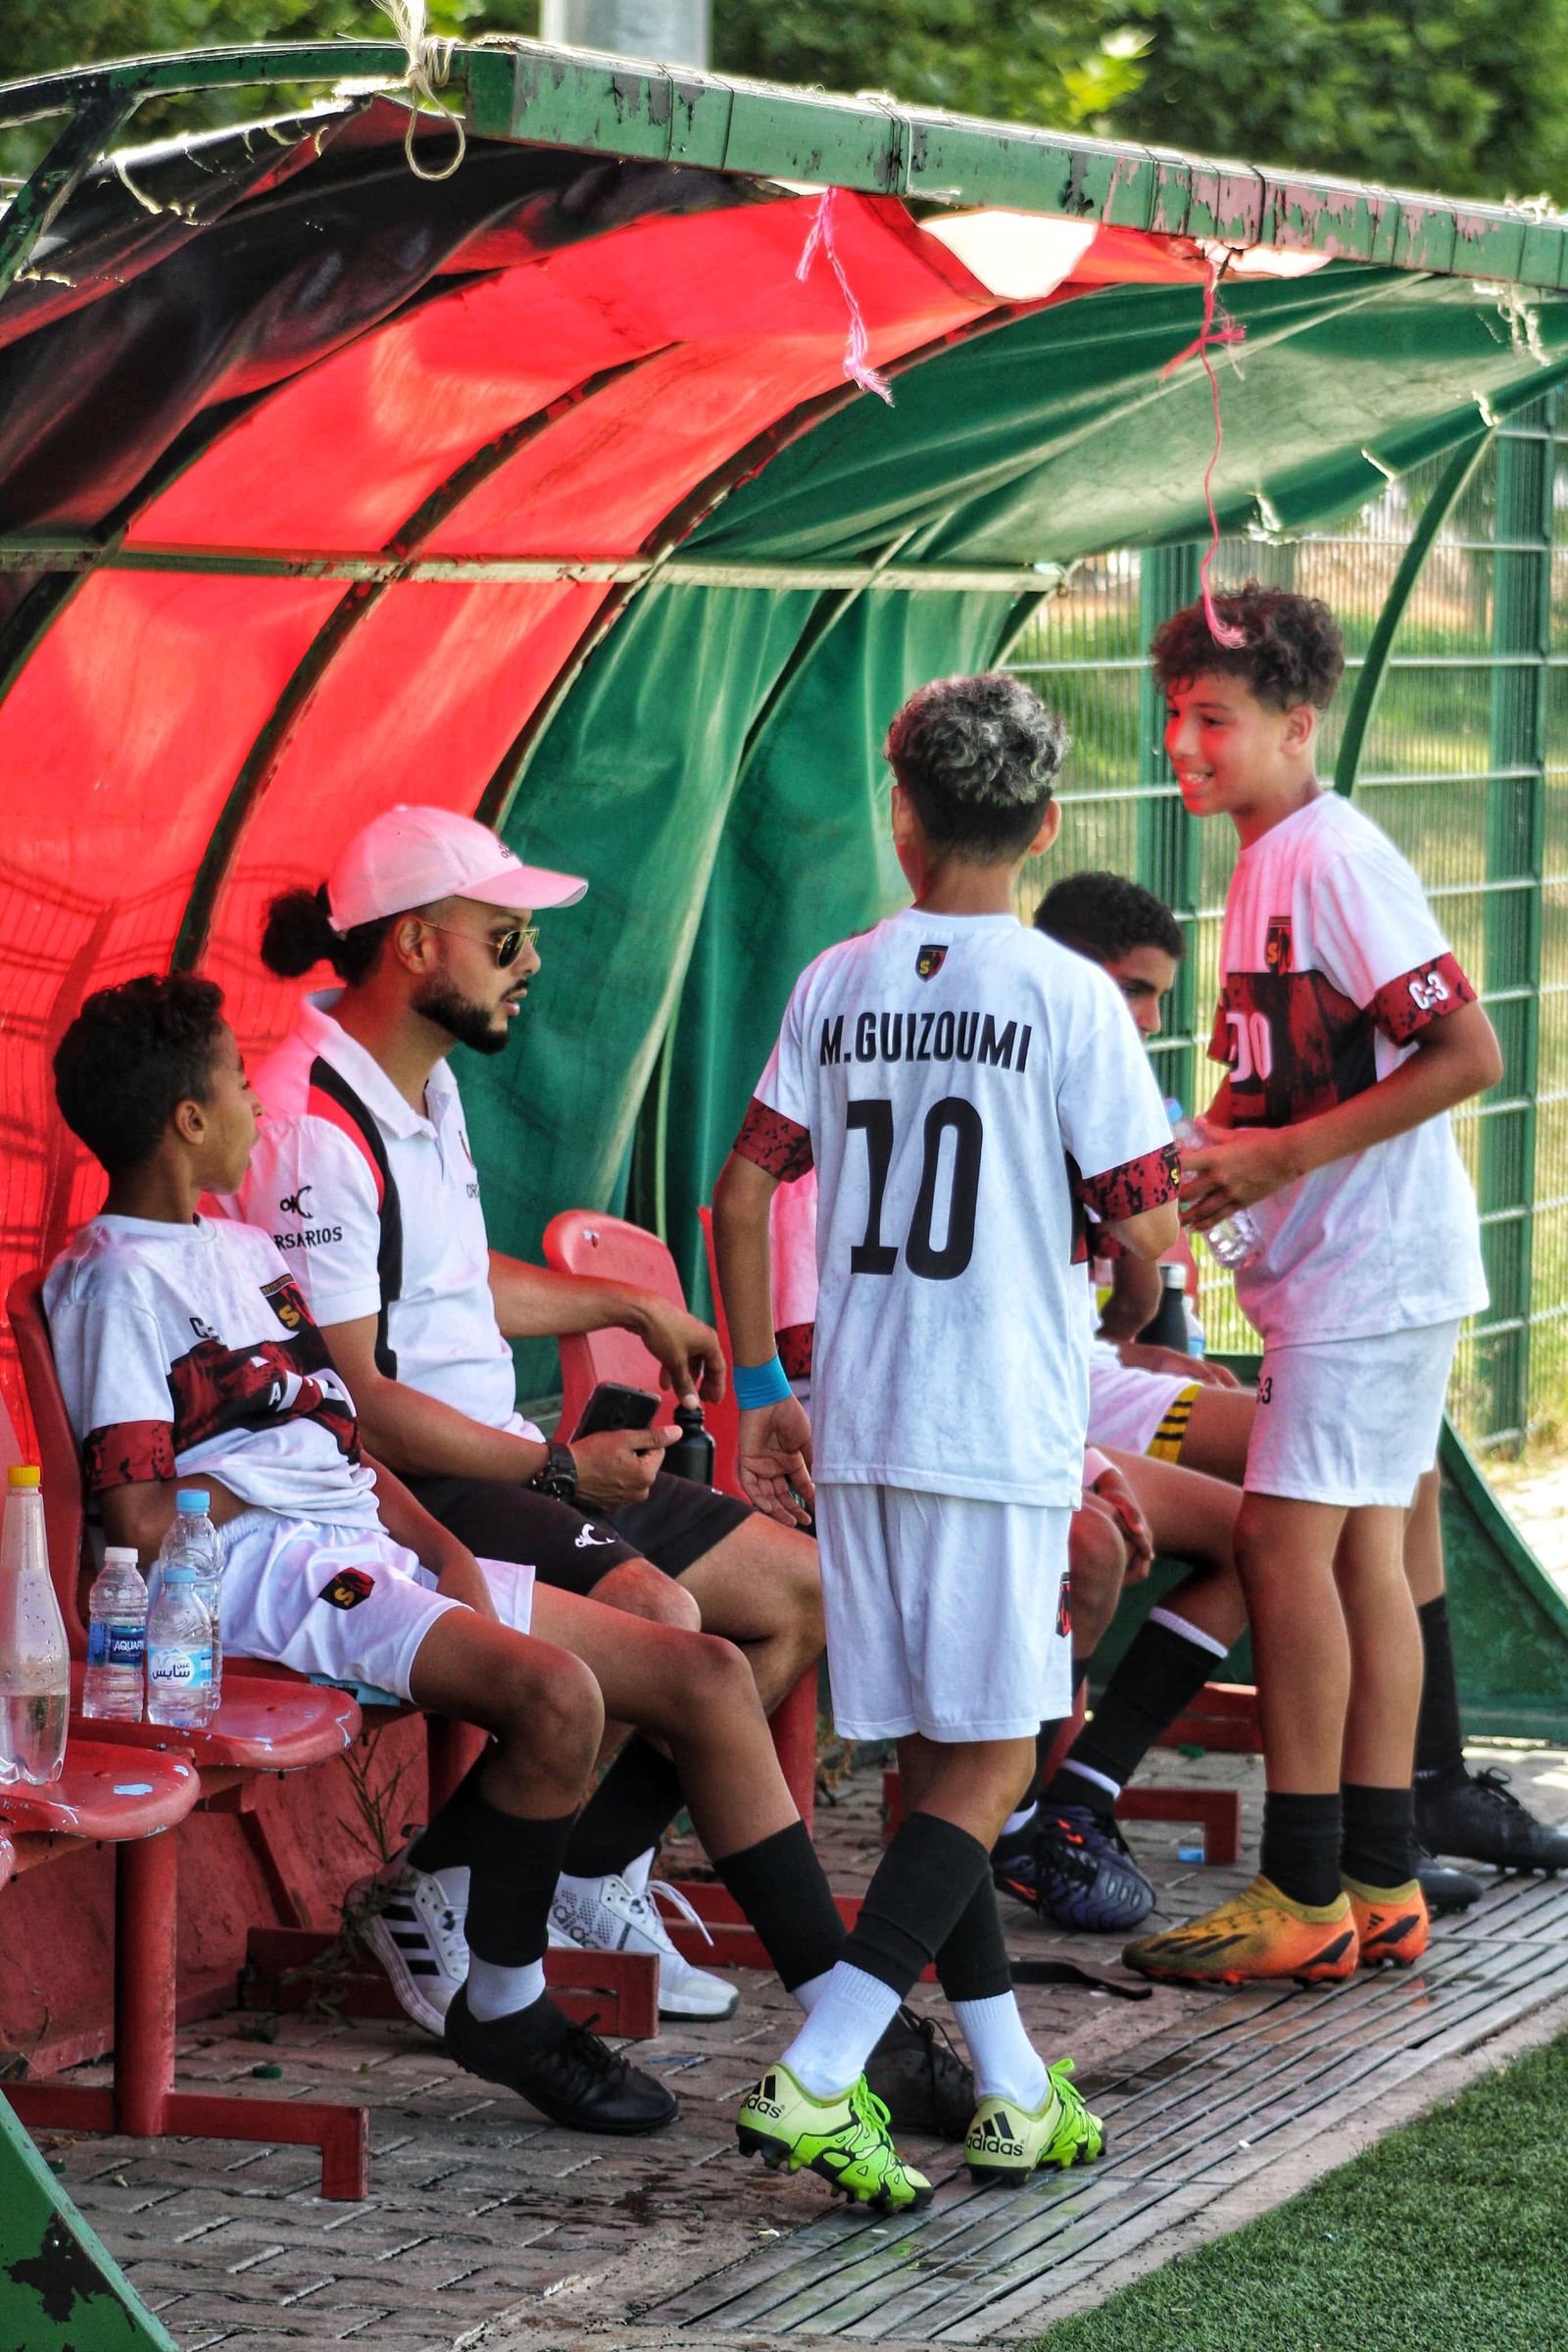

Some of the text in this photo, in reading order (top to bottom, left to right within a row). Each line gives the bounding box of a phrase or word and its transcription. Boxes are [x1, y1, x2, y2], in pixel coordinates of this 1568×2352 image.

[819, 1010, 1032, 1074] M.GUIZOUMI
[846, 1096, 984, 1281] 10
[277, 1304, 301, 1328] S
[333, 1587, 355, 1607] S
[152, 1664, 190, 1681] سايس
[965, 2132, 1024, 2158] adidas
